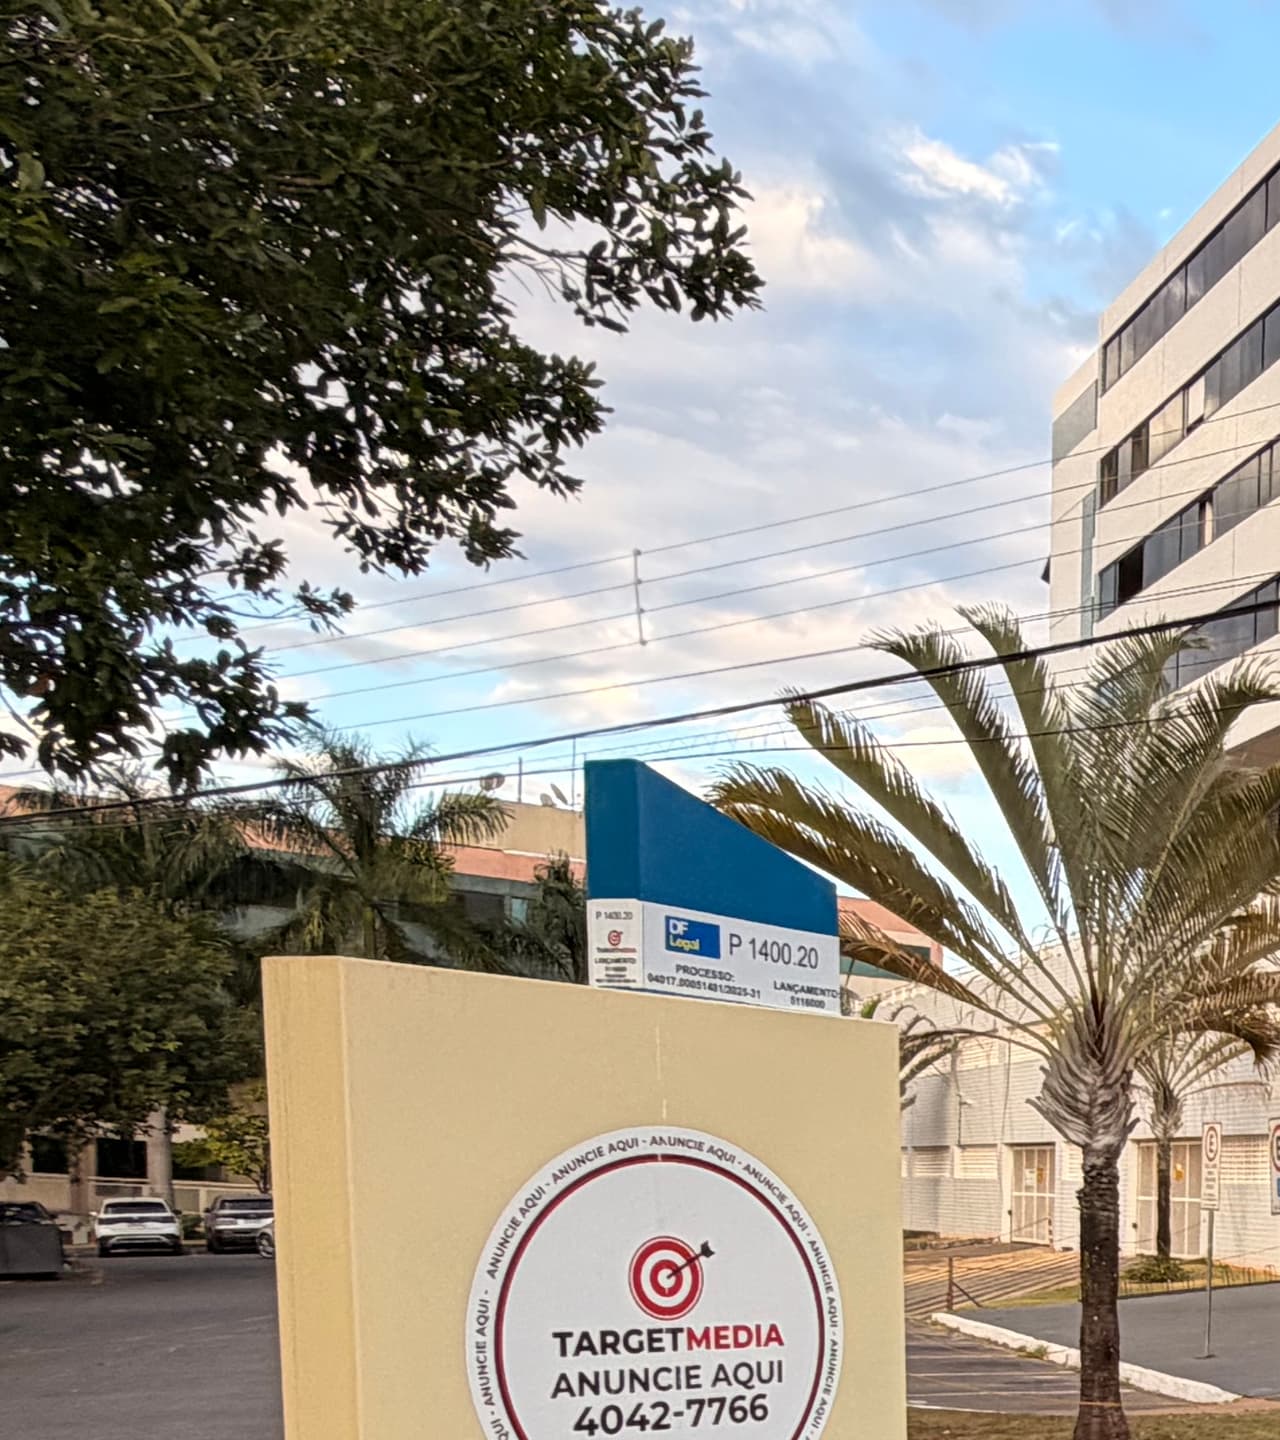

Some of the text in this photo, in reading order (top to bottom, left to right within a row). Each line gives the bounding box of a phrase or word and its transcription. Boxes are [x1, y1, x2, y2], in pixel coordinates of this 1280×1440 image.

[668, 919, 688, 934] DF
[669, 935, 700, 952] Legal
[729, 933, 818, 969] P 1400.20
[551, 1137, 639, 1185] ANUNCIE AQUI
[706, 1146, 736, 1164] AQUI
[742, 1164, 808, 1232] ANUNCIE AQUI
[486, 1186, 546, 1280] ANUNCIE AQUI
[476, 1299, 496, 1408] ANUNCIE AQUI
[552, 1323, 784, 1358] TARGETMEDIA
[550, 1360, 784, 1399] ANUNCIE AQUI
[573, 1394, 769, 1436] 4042-7766
